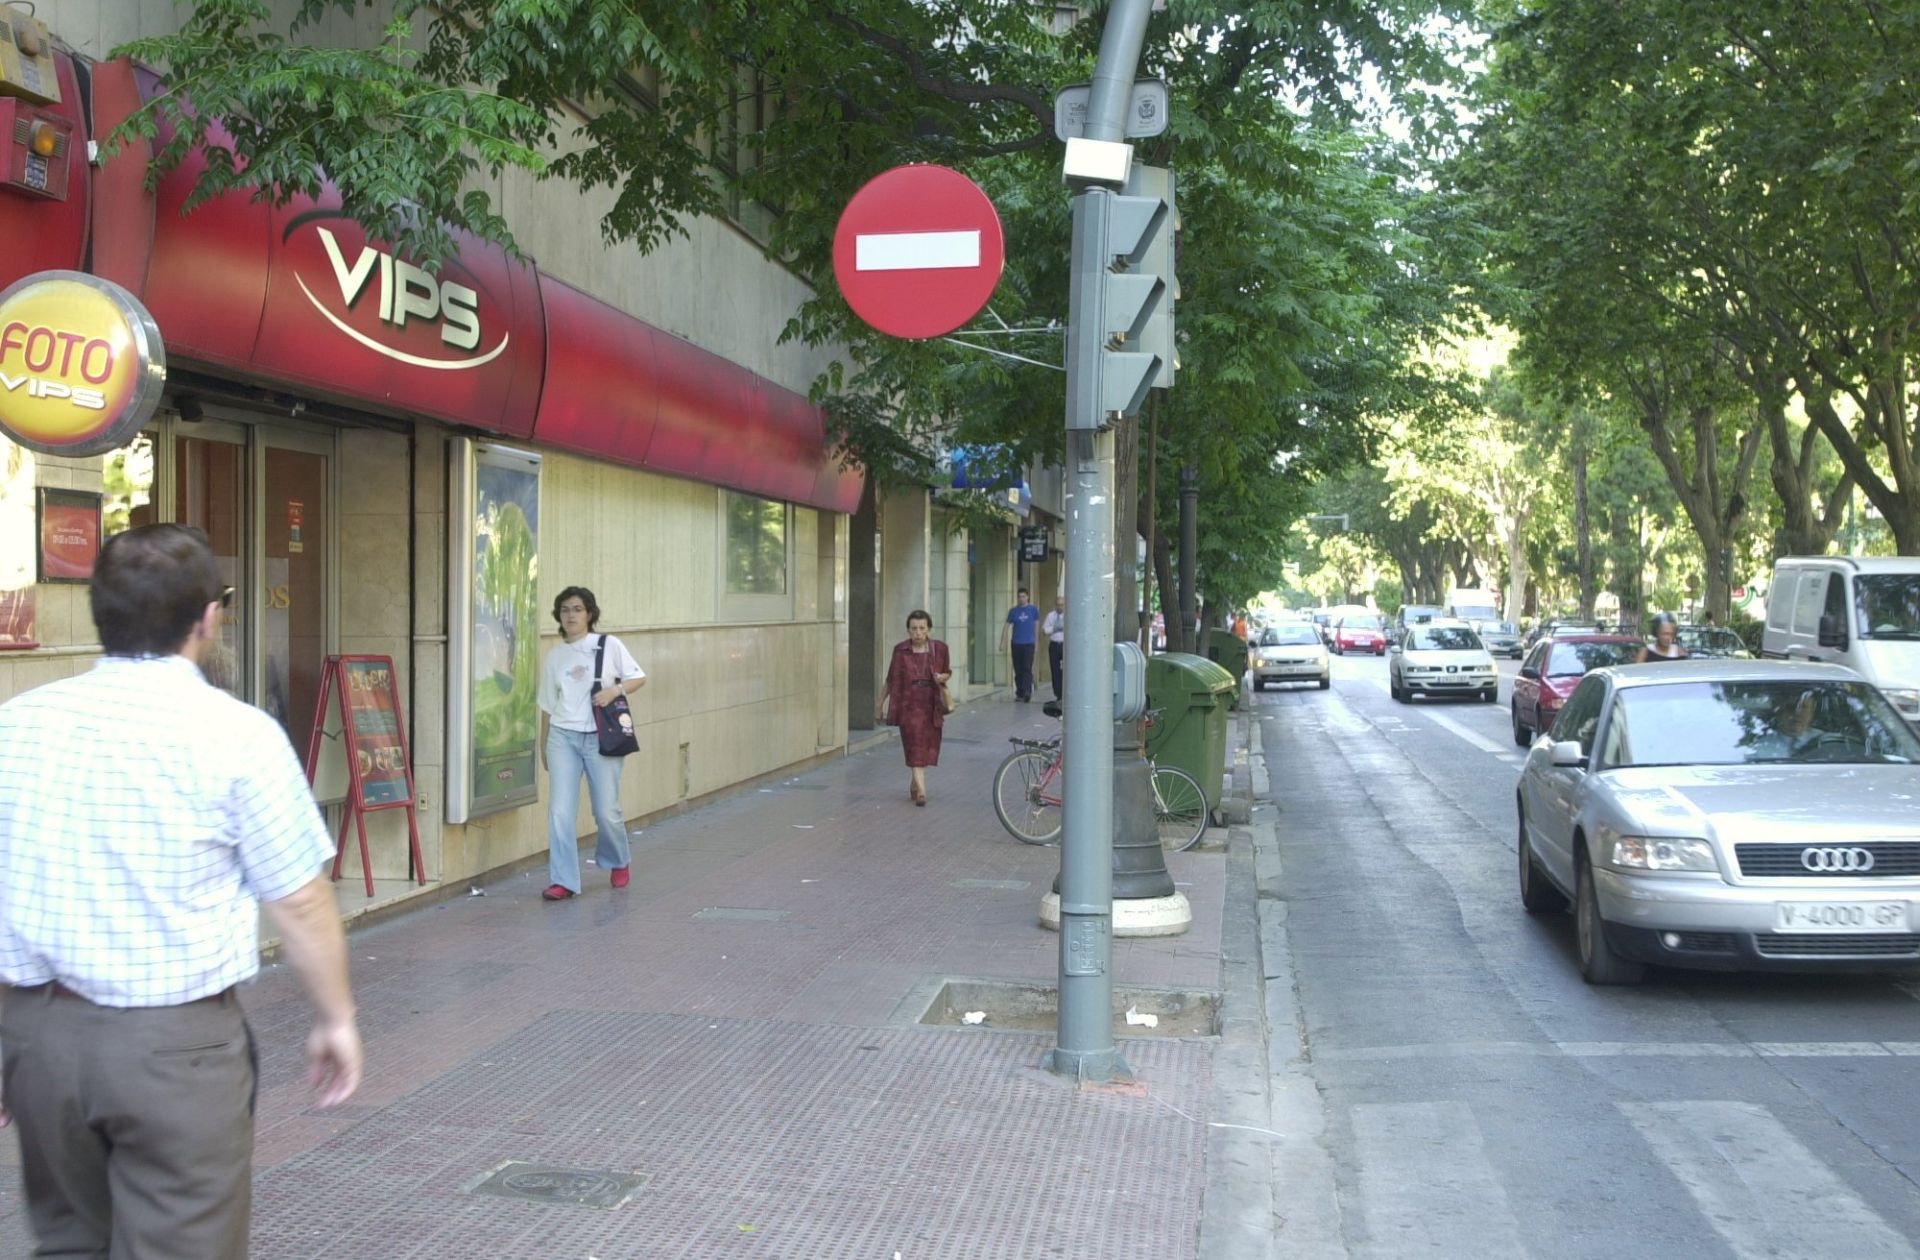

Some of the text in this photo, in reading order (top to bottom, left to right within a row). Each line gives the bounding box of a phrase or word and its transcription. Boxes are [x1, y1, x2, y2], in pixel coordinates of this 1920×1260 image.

[316, 226, 480, 349] VIPS
[0, 321, 115, 385] FOTO
[0, 371, 106, 410] VIPS
